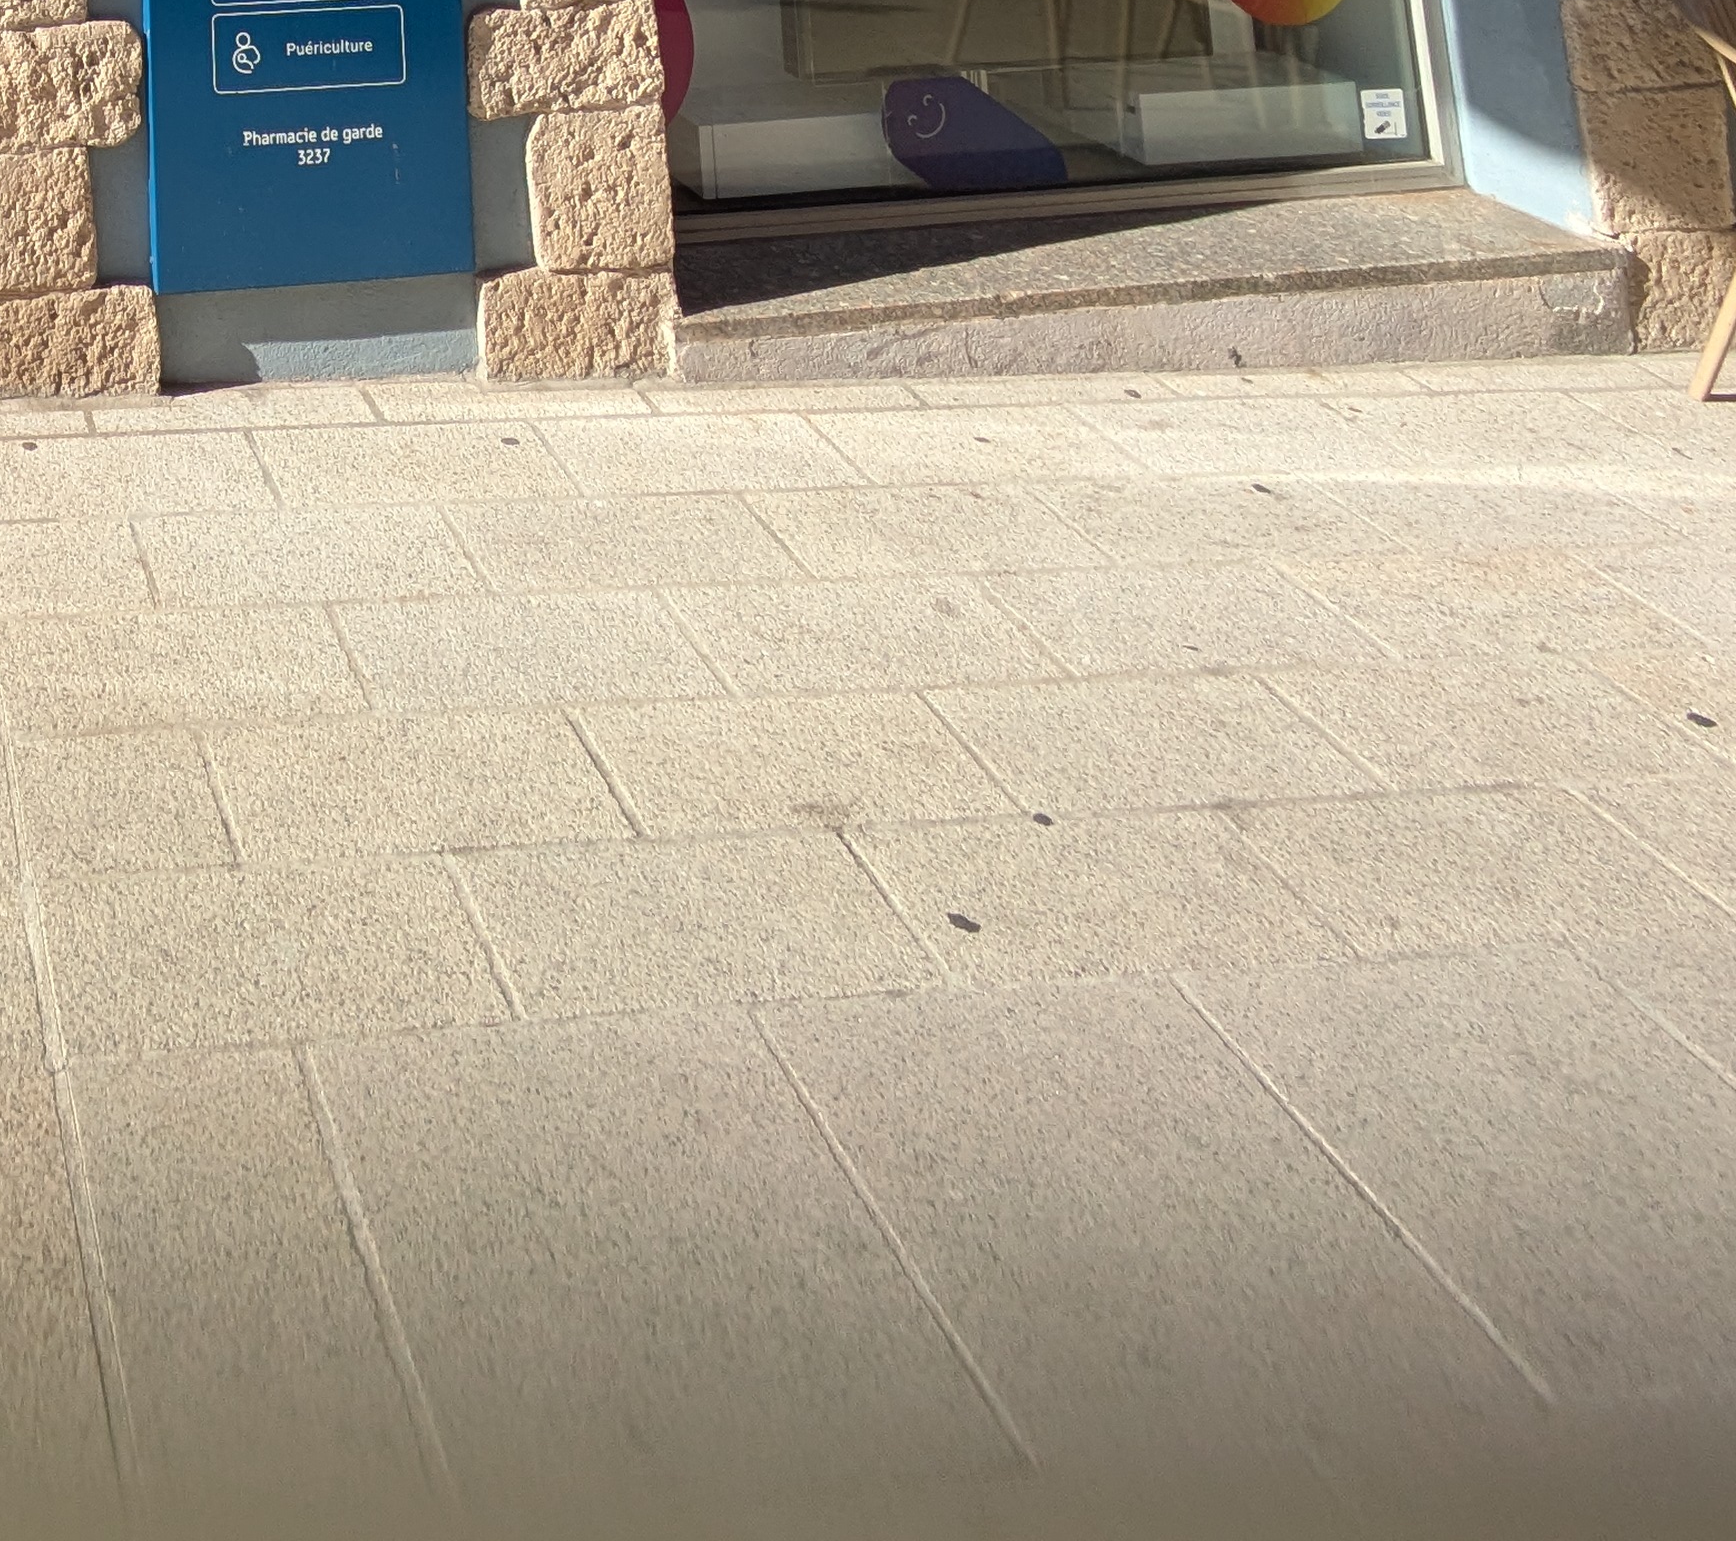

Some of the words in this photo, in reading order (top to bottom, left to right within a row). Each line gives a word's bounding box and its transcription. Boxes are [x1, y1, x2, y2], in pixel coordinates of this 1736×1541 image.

[286, 39, 374, 55] Puériculture
[242, 129, 318, 146] Pharmacie
[321, 128, 338, 142] de
[342, 125, 383, 144] garde
[297, 150, 331, 166] 3237
